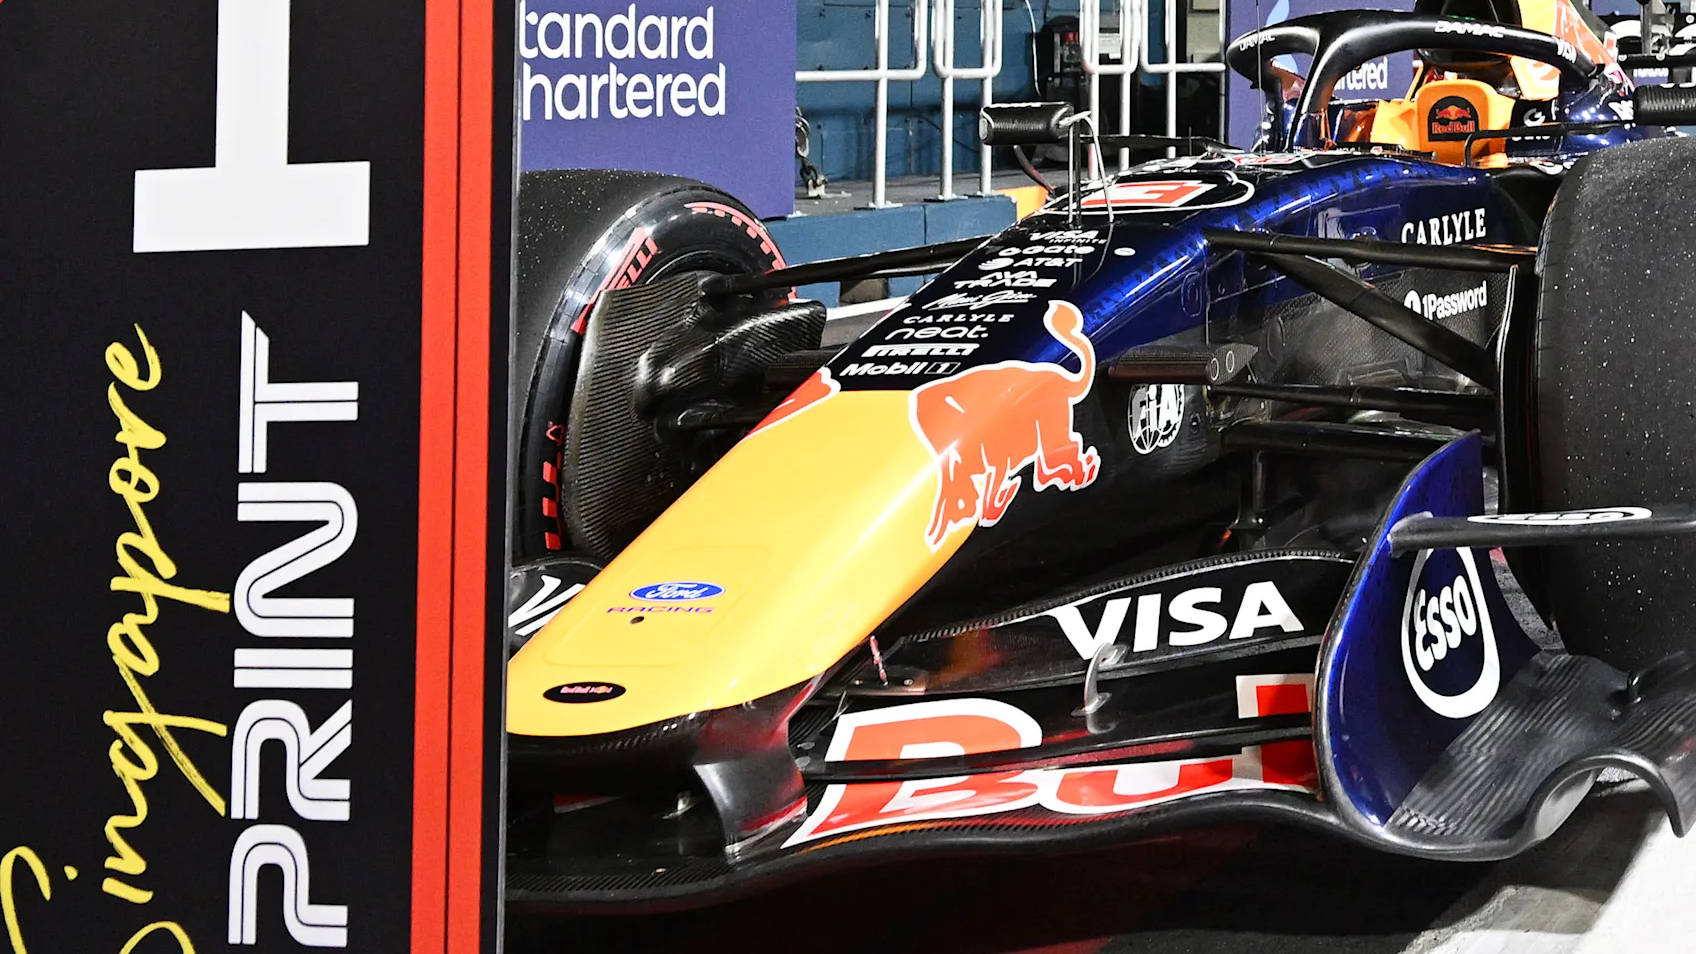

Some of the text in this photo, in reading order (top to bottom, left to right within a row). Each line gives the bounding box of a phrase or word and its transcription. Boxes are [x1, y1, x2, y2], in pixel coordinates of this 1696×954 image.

[519, 0, 714, 60] tandard
[1434, 20, 1506, 38] DAMAC
[522, 62, 726, 121] hartered
[1431, 119, 1475, 134] Red Bull
[1030, 230, 1099, 241] VISA
[1401, 208, 1486, 246] CARLYLE
[1013, 257, 1083, 268] AT&T
[954, 278, 1057, 289] TRADE
[1423, 281, 1488, 321] 1Password
[903, 313, 1015, 324] CARLYLE
[861, 343, 981, 357] PIRELLI
[840, 360, 929, 377] Mobil
[653, 583, 706, 600] Ford
[228, 310, 359, 948] PRINT
[1046, 581, 1305, 660] VISA
